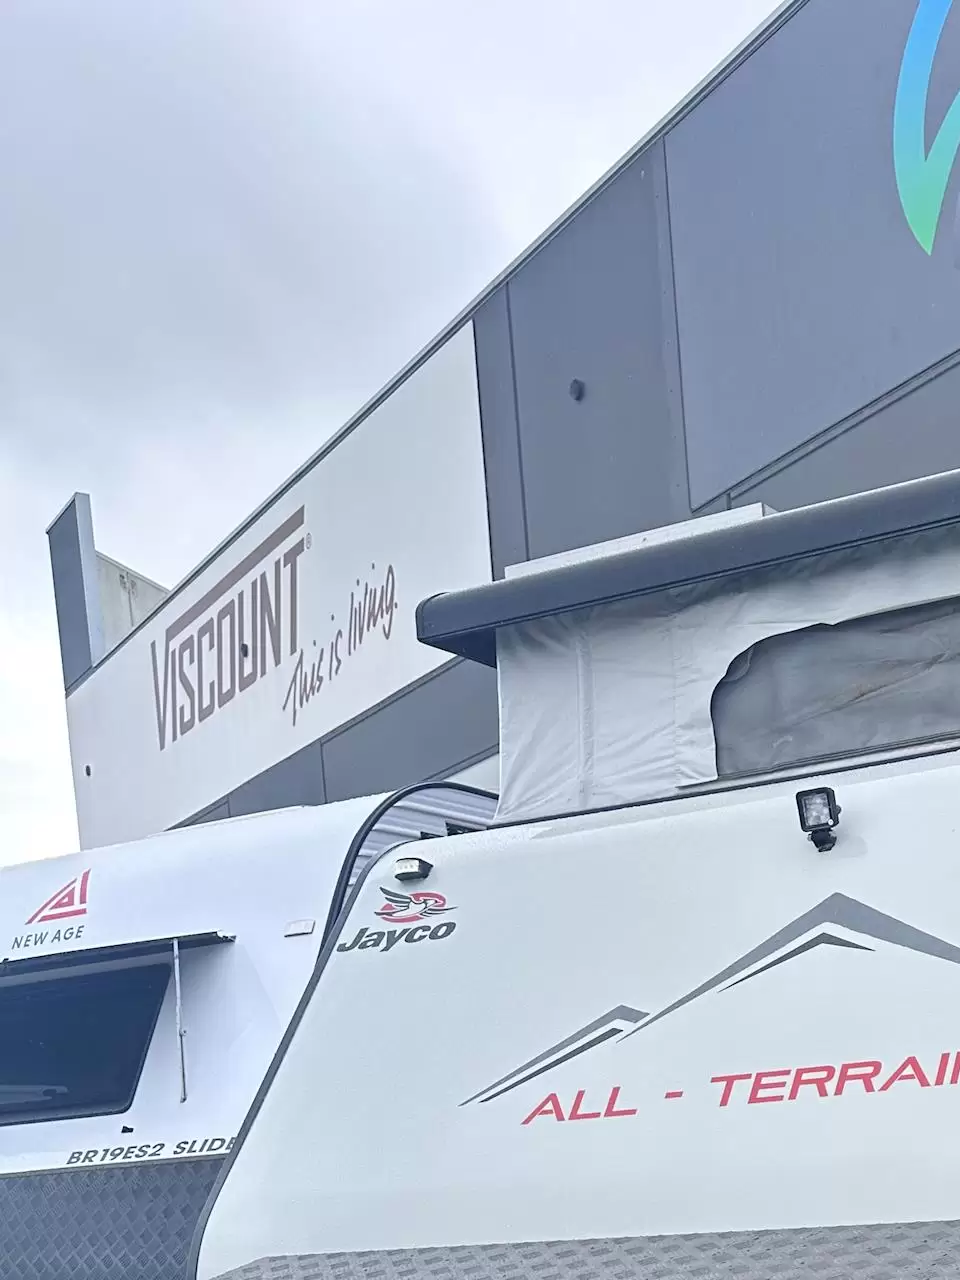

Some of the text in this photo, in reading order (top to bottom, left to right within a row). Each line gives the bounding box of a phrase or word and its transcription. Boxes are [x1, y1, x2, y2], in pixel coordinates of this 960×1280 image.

[282, 639, 325, 727] This
[329, 613, 343, 681] is
[11, 925, 86, 951] NEW AGE
[336, 921, 457, 952] Jayco
[520, 1086, 638, 1125] ALL
